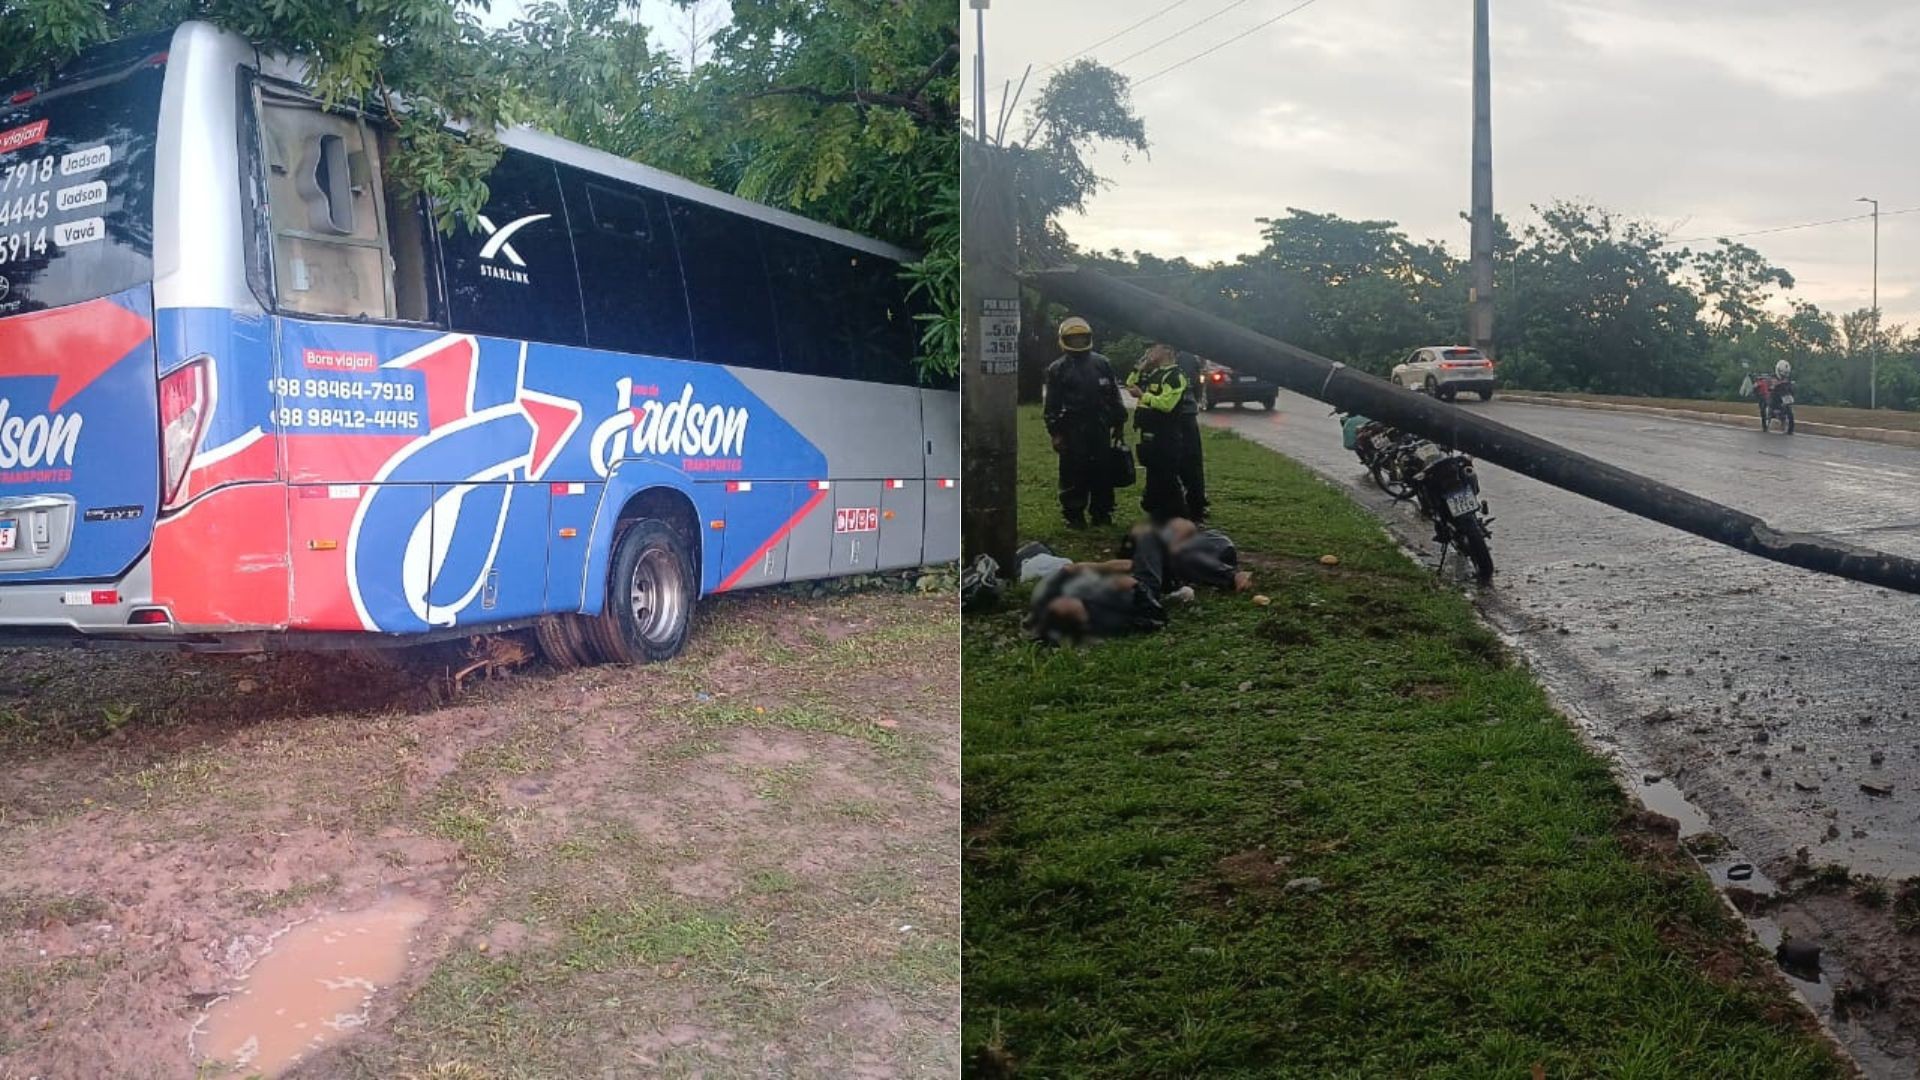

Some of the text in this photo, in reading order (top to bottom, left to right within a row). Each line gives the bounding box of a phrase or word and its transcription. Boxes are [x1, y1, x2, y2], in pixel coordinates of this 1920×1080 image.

[65, 151, 106, 171] Jadson
[61, 187, 102, 207] Jadson
[64, 222, 95, 242] Vavá
[480, 264, 530, 285] STARLINK
[307, 351, 373, 371] Bora viajar!
[305, 379, 414, 401] 98464-7918
[307, 408, 418, 428] 98412-4445
[590, 376, 748, 478] Jadson
